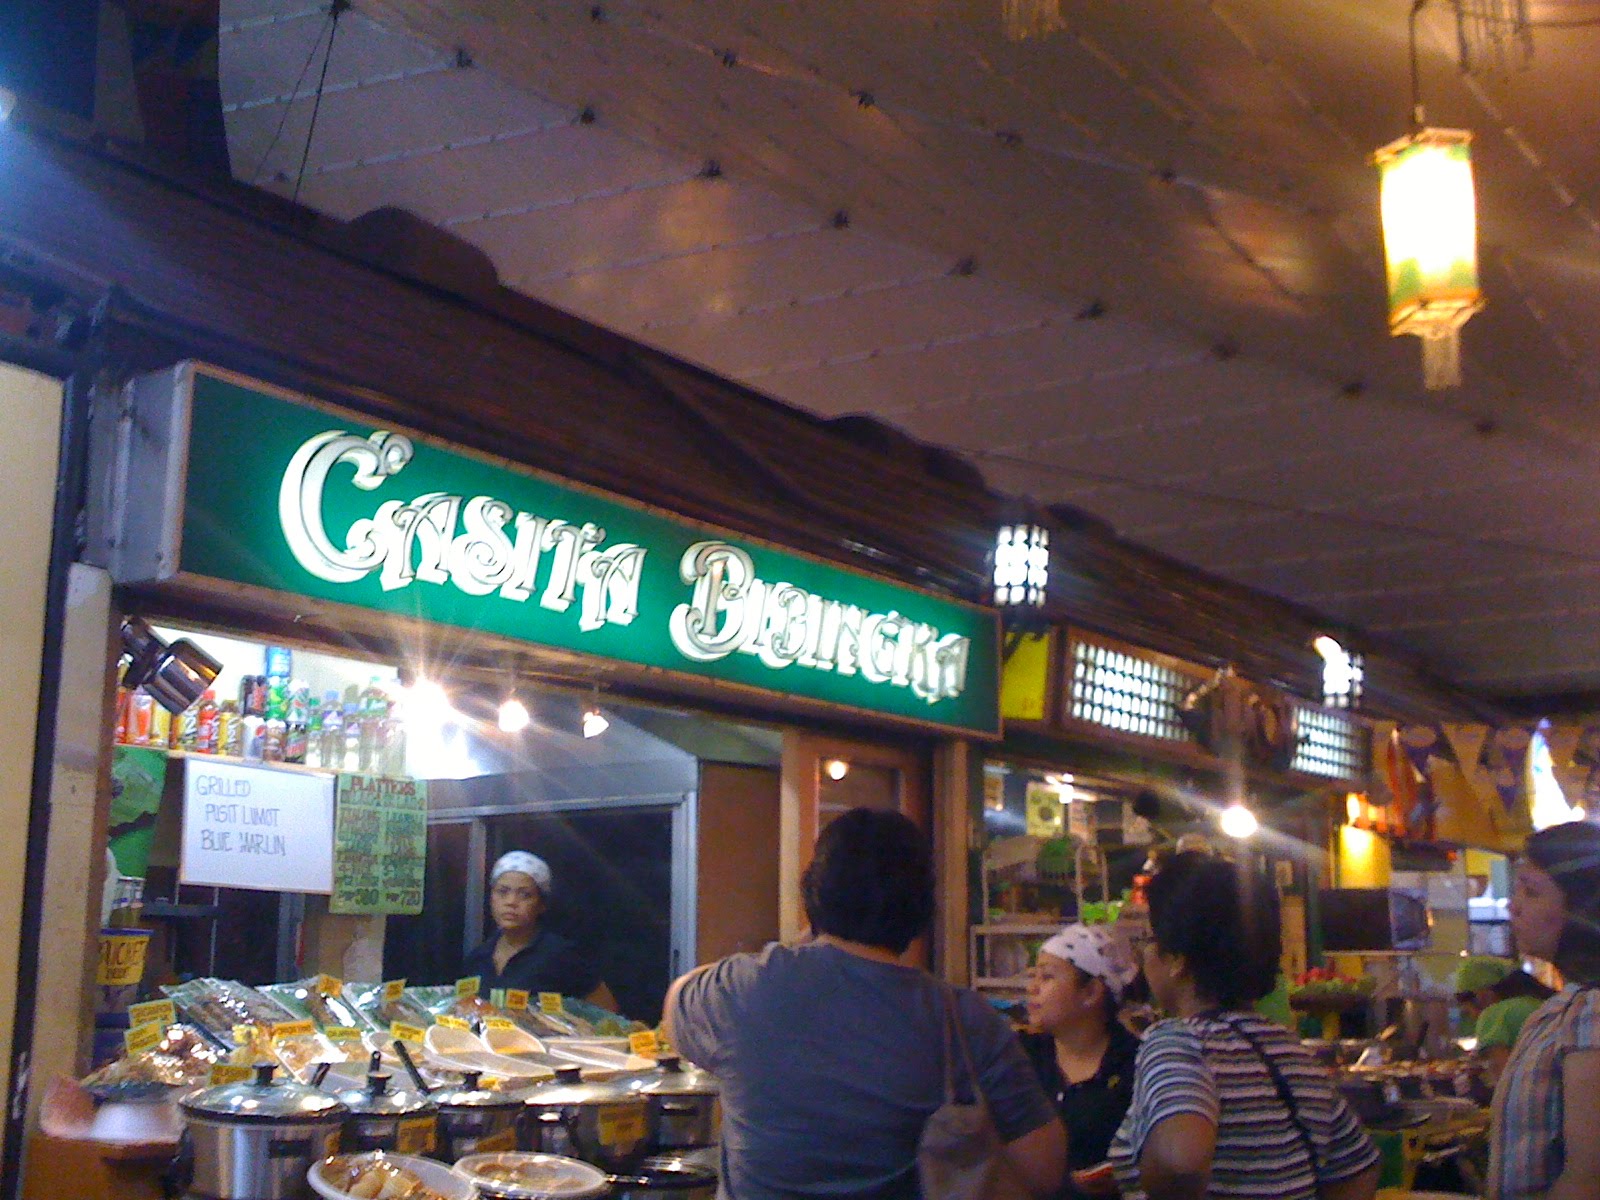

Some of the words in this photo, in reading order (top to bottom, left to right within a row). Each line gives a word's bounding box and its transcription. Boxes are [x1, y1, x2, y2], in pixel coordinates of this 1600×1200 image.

[195, 774, 252, 797] GRILLED
[242, 805, 281, 827] LUMOT
[201, 829, 233, 852] BLUE
[239, 831, 287, 857] MARLIN
